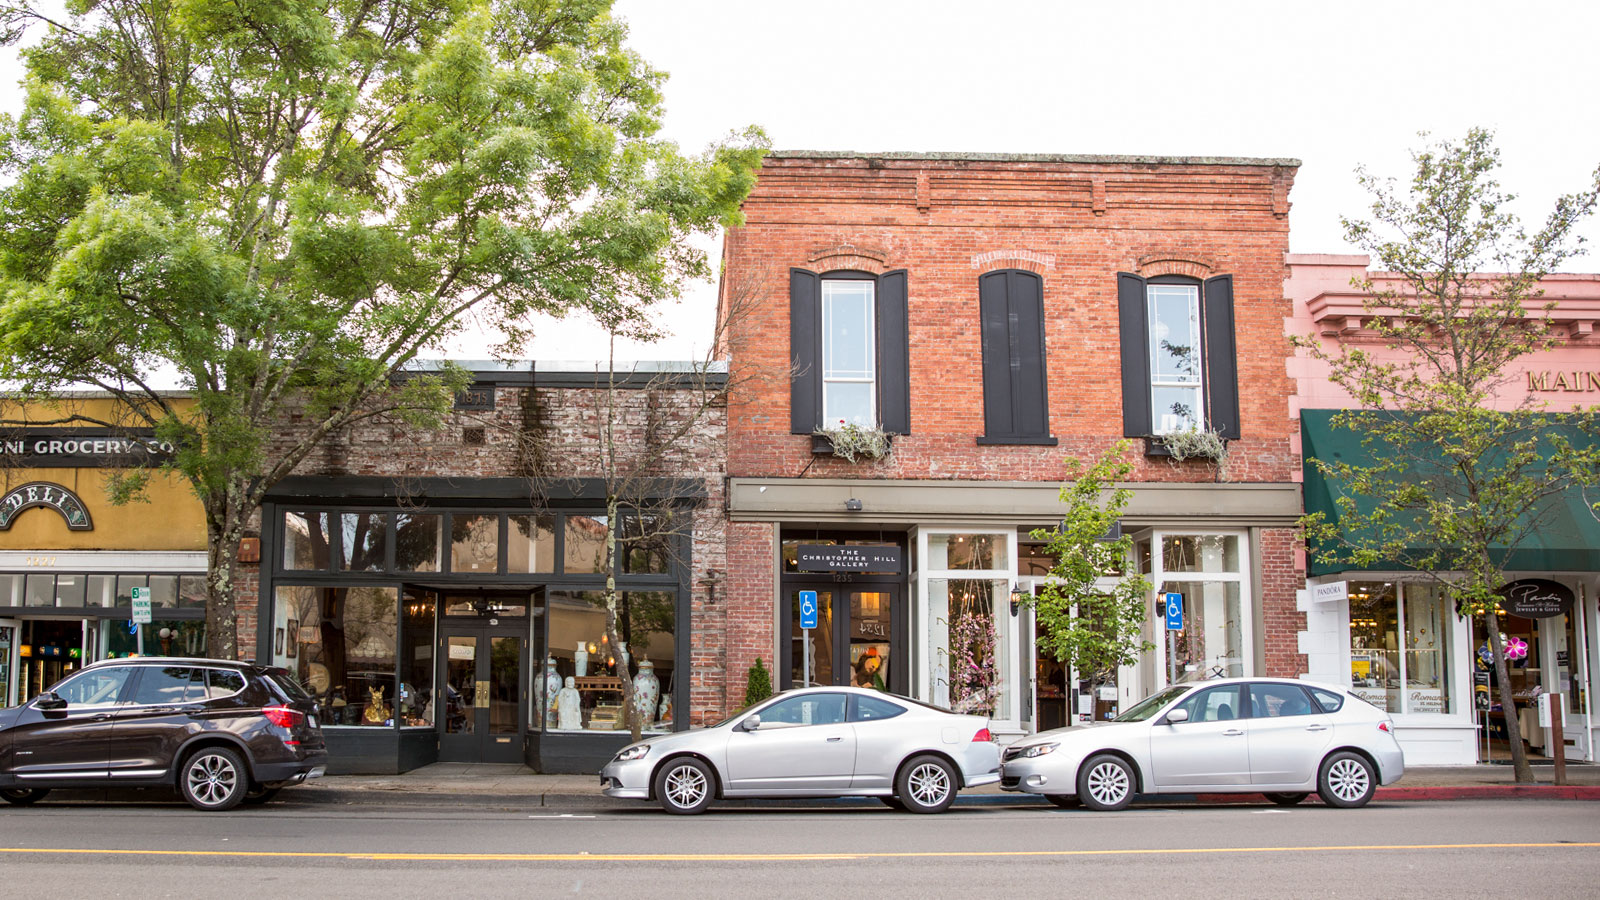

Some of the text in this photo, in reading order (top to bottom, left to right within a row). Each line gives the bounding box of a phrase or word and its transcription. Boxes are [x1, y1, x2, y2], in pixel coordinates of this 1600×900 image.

[1526, 371, 1600, 392] MAIN
[34, 440, 136, 454] GROCERY
[6, 486, 68, 509] DELI
[26, 556, 57, 567] 1227
[833, 574, 853, 582] 1235
[133, 589, 138, 598] 3
